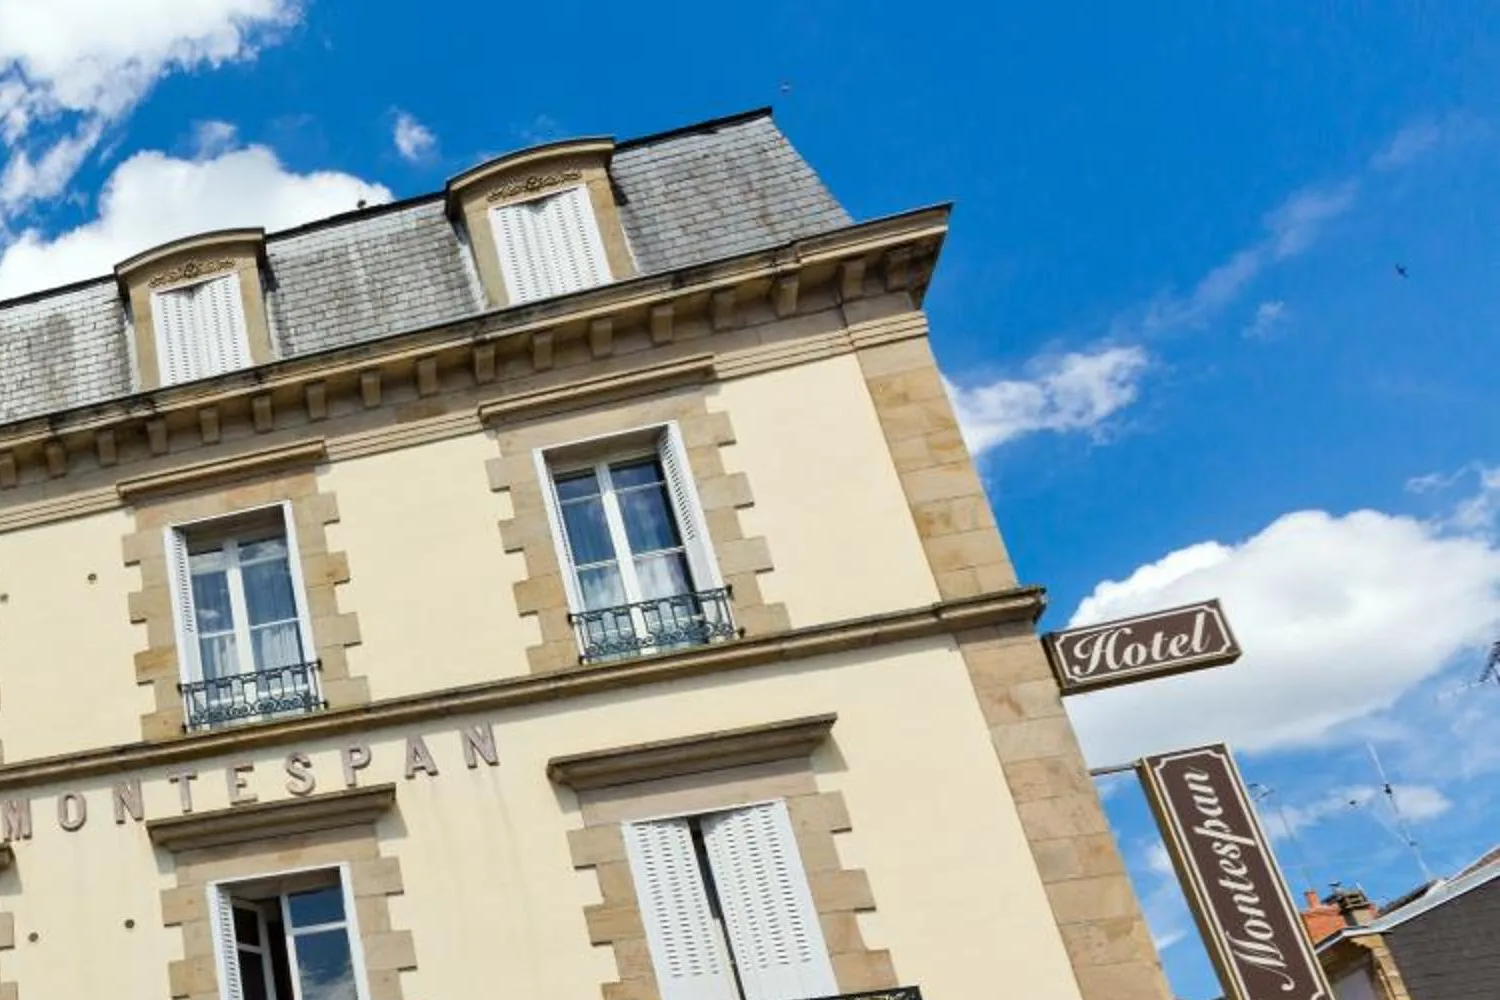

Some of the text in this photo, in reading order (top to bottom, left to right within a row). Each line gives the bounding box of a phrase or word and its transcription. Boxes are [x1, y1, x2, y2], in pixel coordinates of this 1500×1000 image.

[1073, 611, 1211, 676] Hotel
[0, 720, 500, 842] MONTESPAN
[1183, 765, 1296, 991] Montespan
